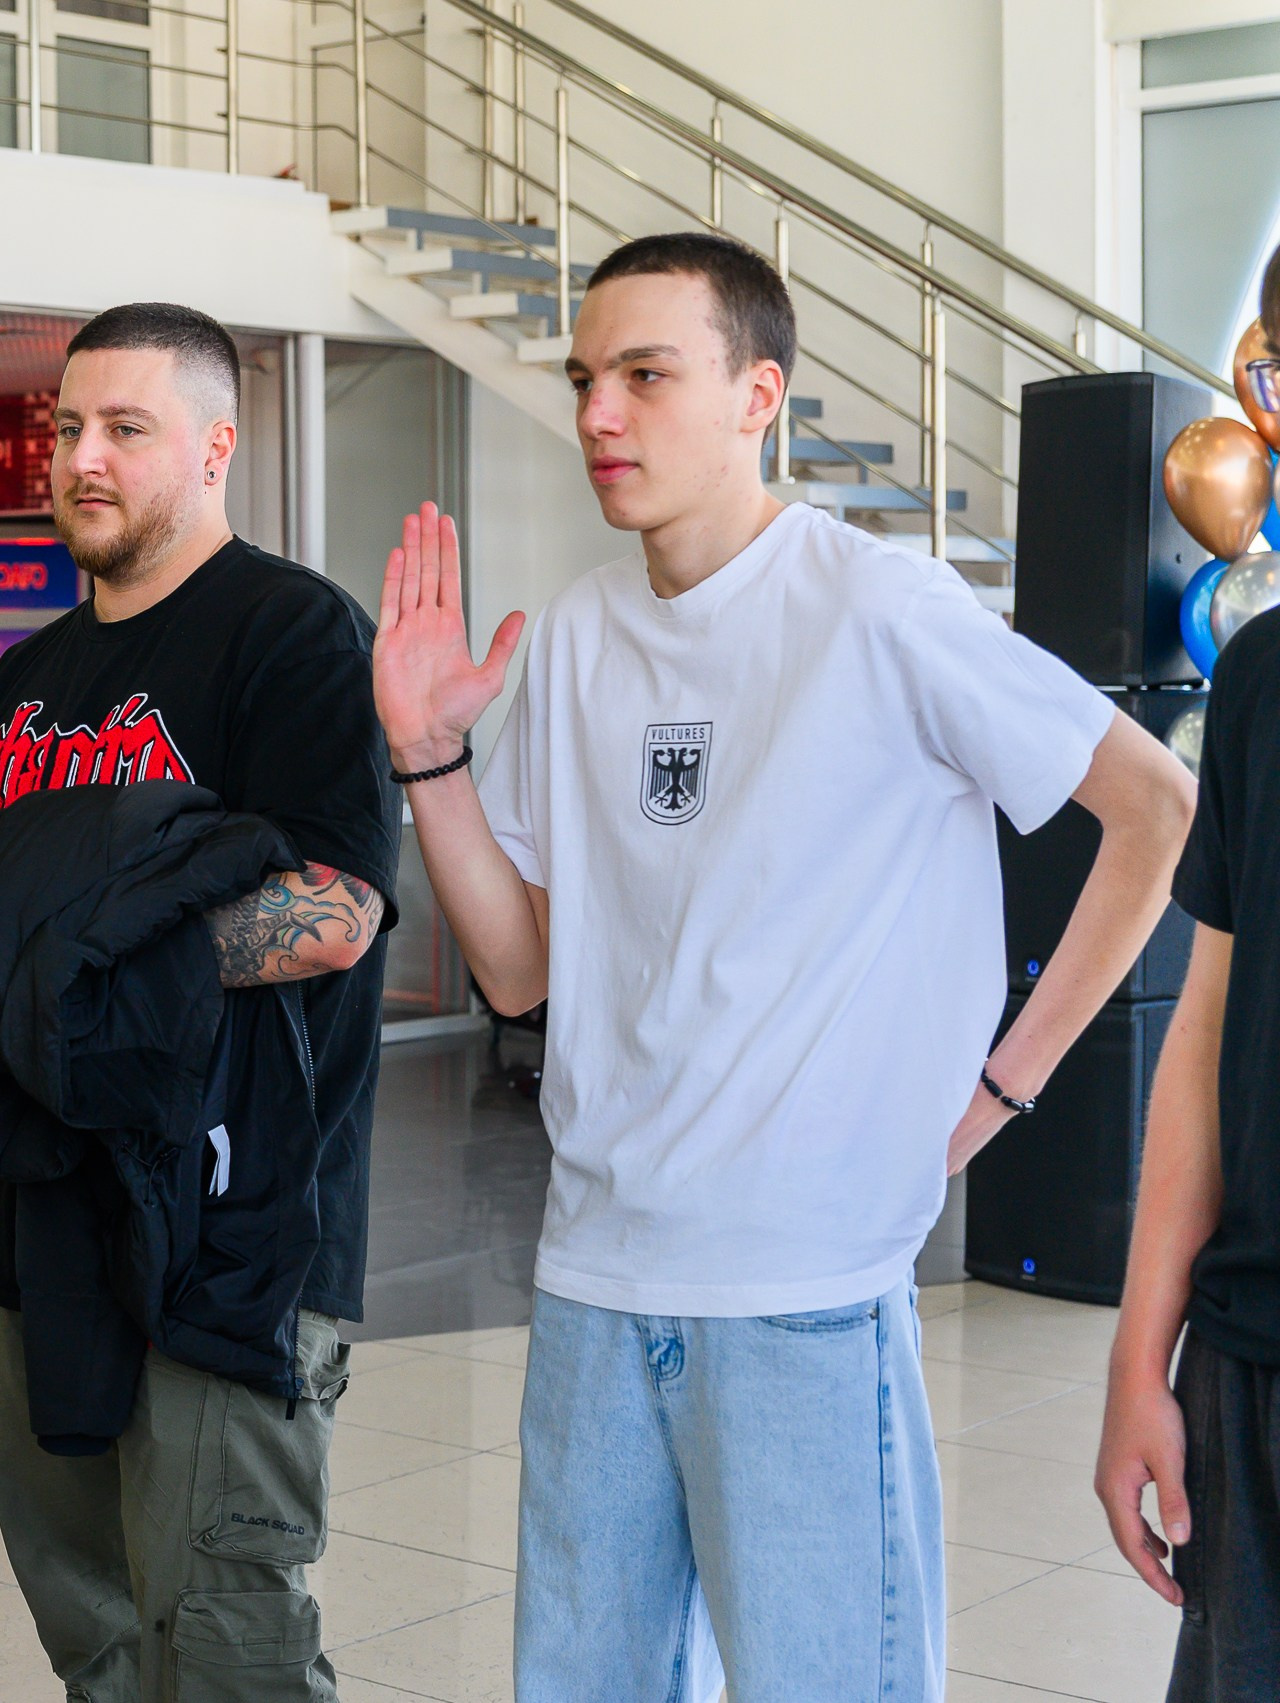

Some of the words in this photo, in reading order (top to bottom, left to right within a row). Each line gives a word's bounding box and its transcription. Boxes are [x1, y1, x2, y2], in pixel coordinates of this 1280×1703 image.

[651, 728, 705, 740] VULTURES
[231, 1513, 270, 1527] BLACK
[272, 1520, 305, 1535] SQUAD
